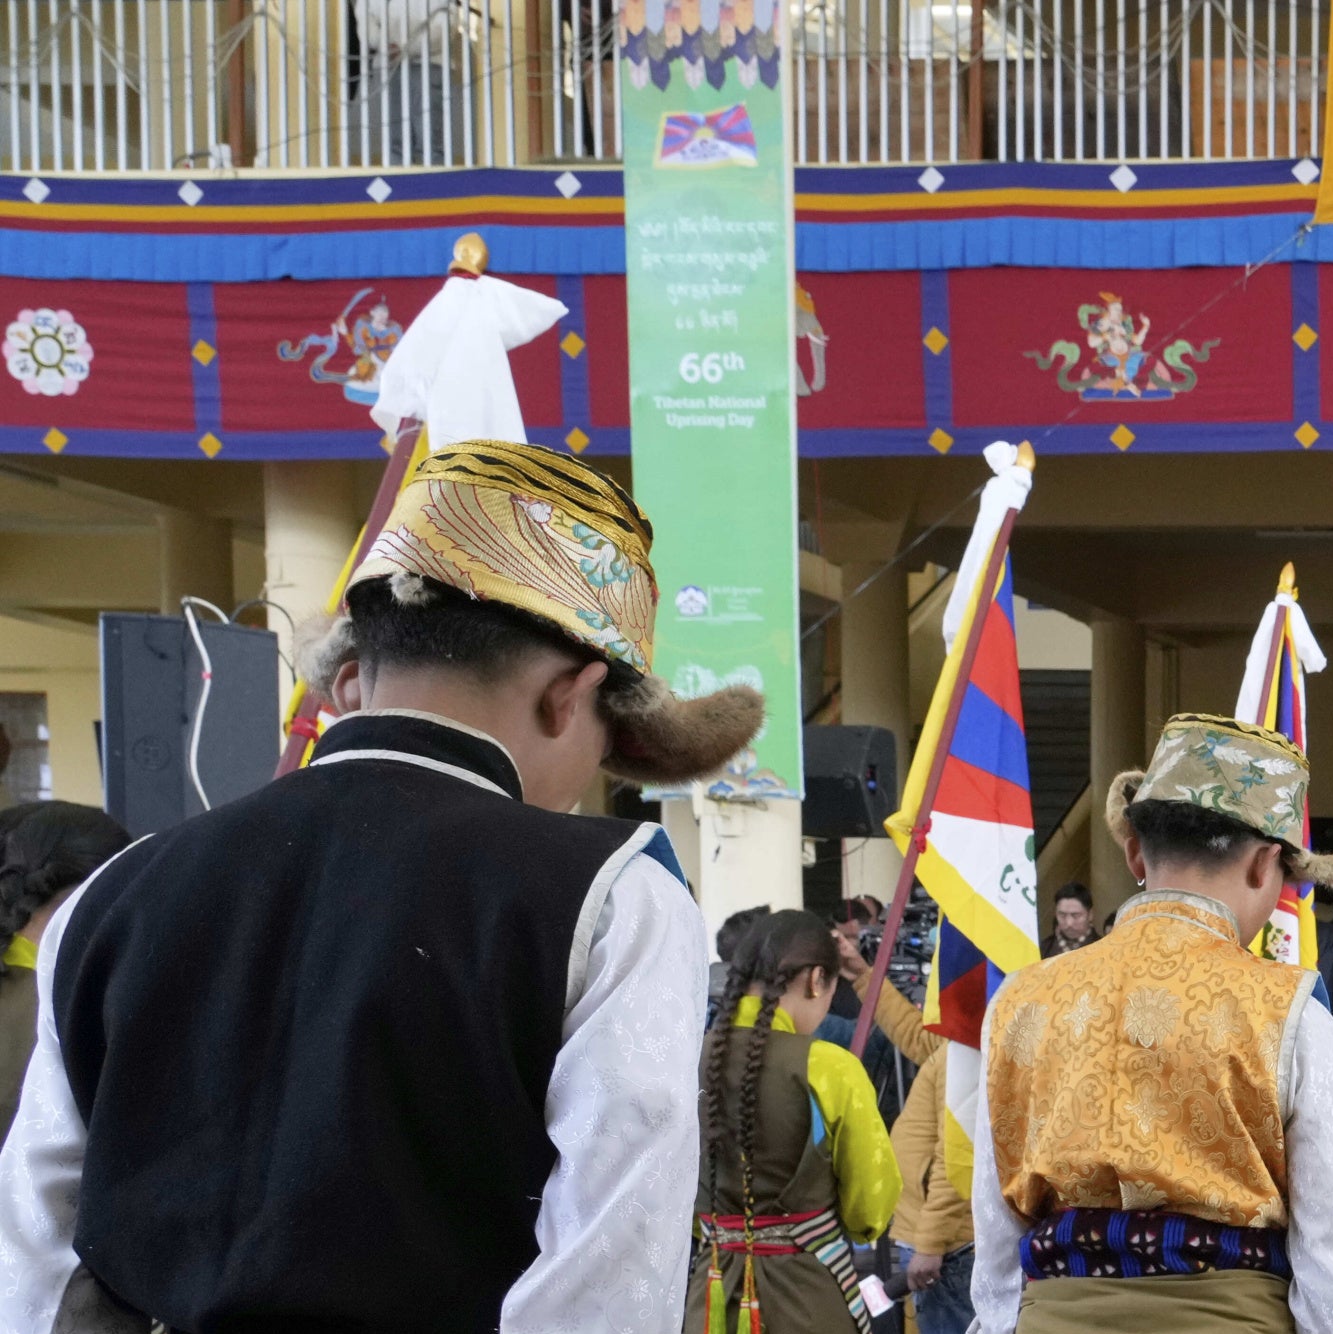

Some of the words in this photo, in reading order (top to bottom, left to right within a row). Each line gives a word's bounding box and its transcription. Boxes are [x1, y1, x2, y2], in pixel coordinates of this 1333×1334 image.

[678, 350, 745, 384] 66th
[653, 395, 706, 409] Tibetan
[707, 395, 767, 409] National
[665, 412, 726, 429] Uprising
[728, 413, 755, 428] Day
